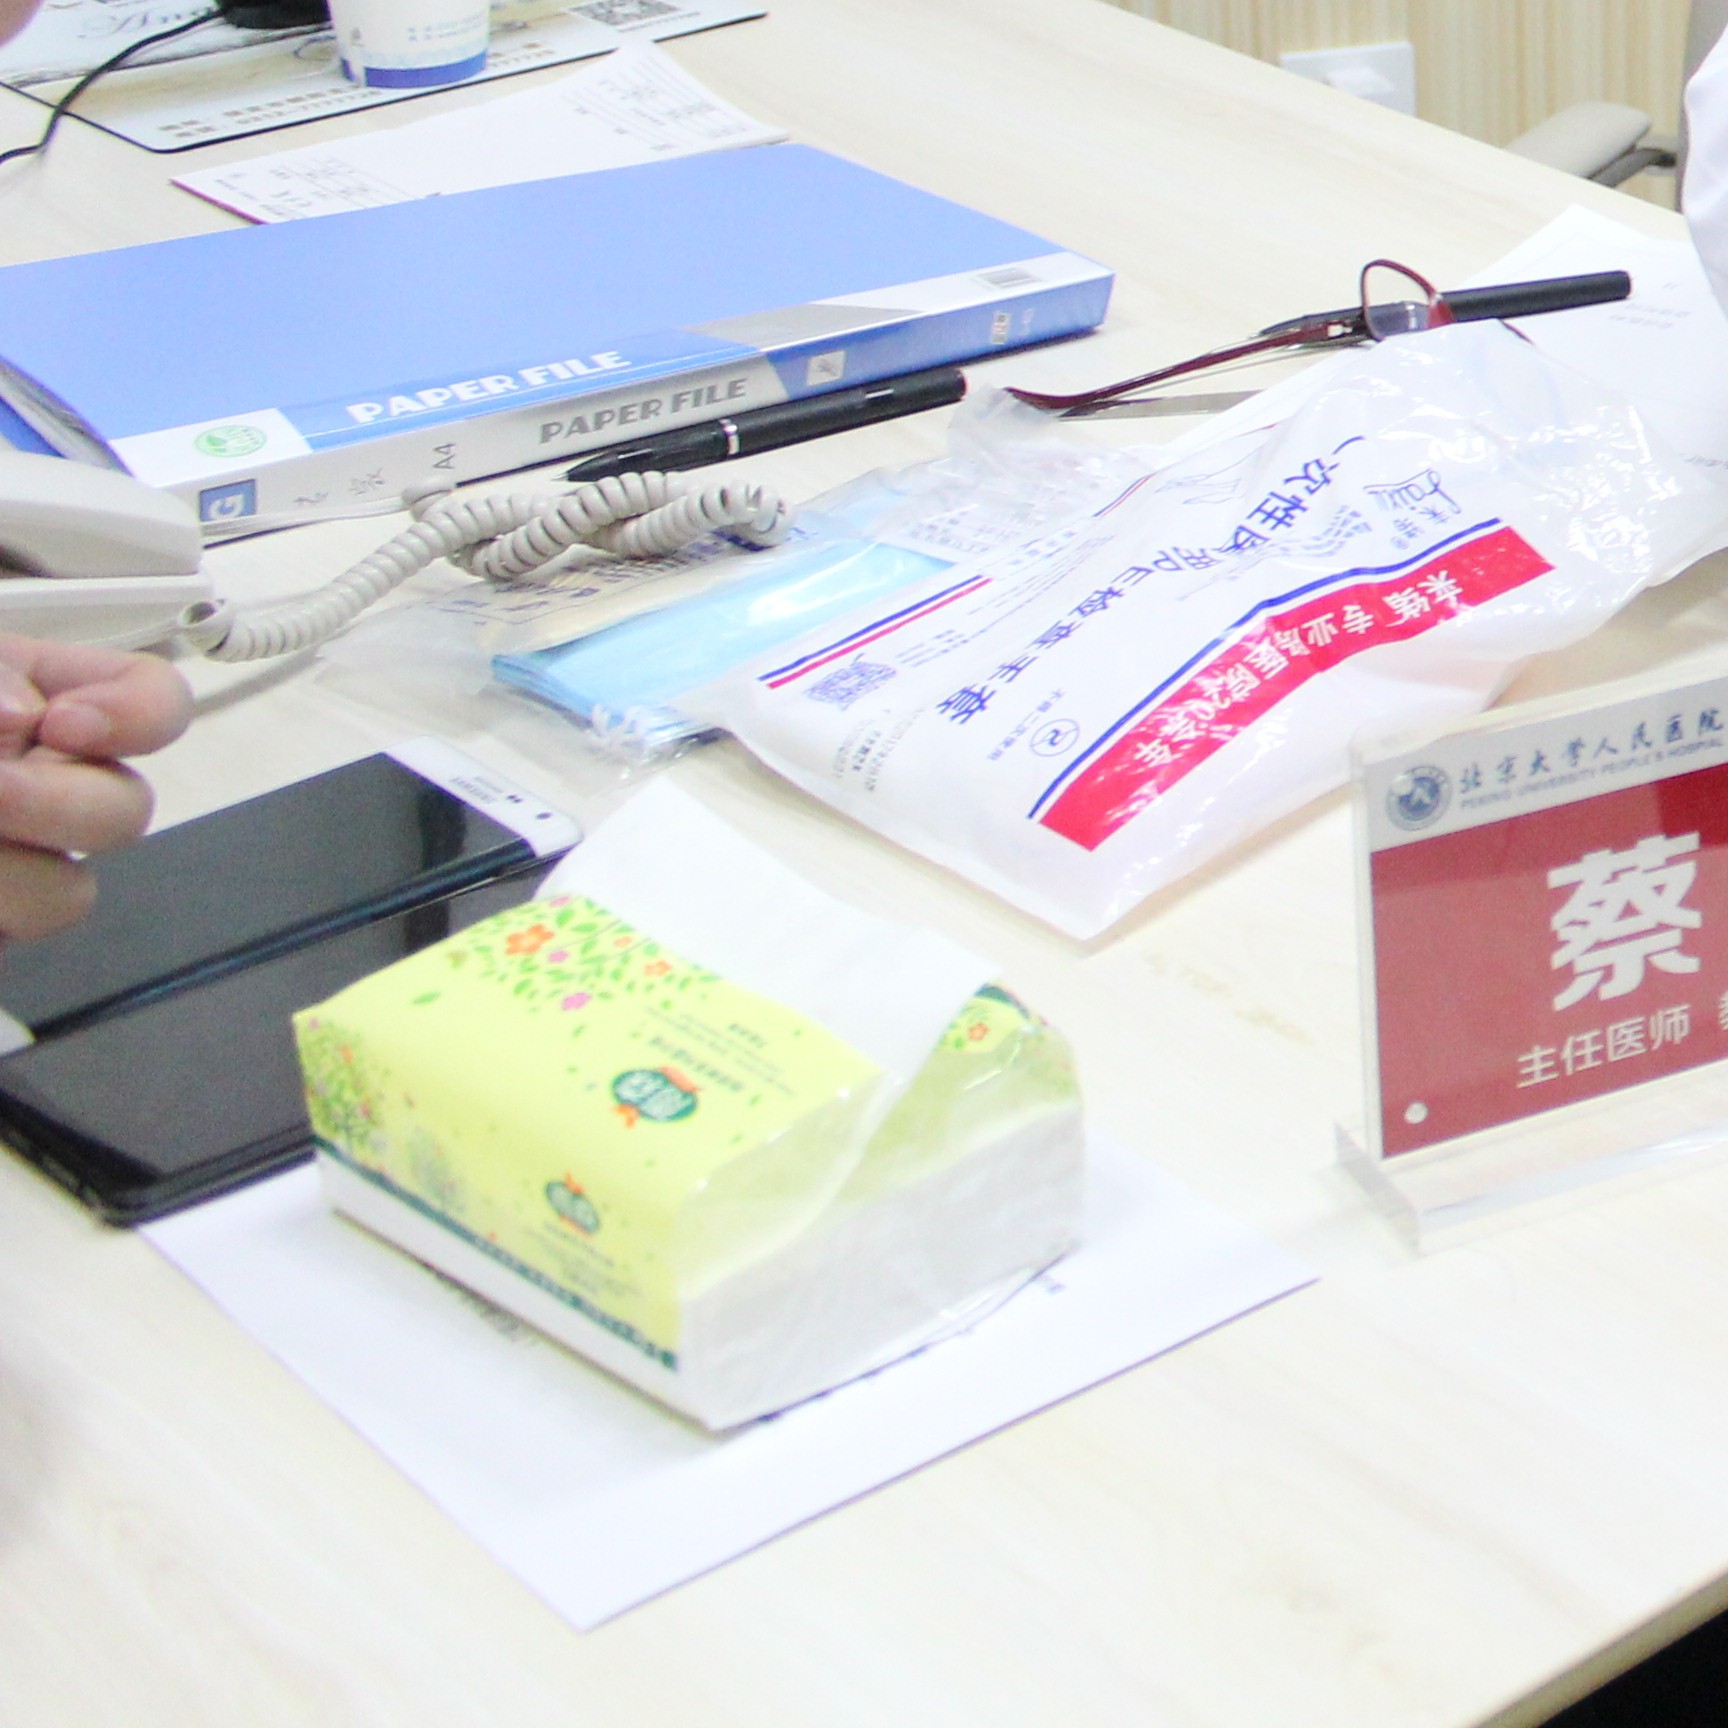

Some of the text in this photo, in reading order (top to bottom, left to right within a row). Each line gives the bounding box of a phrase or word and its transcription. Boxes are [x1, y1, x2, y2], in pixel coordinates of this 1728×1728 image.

[345, 349, 632, 425] PAPER FILE
[538, 377, 750, 445] PAPER FILE
[431, 442, 457, 471] A4
[1459, 707, 1725, 794] 北京大学人民医院
[1548, 832, 1703, 1012] 蔡
[1516, 1001, 1692, 1091] 主任医师
